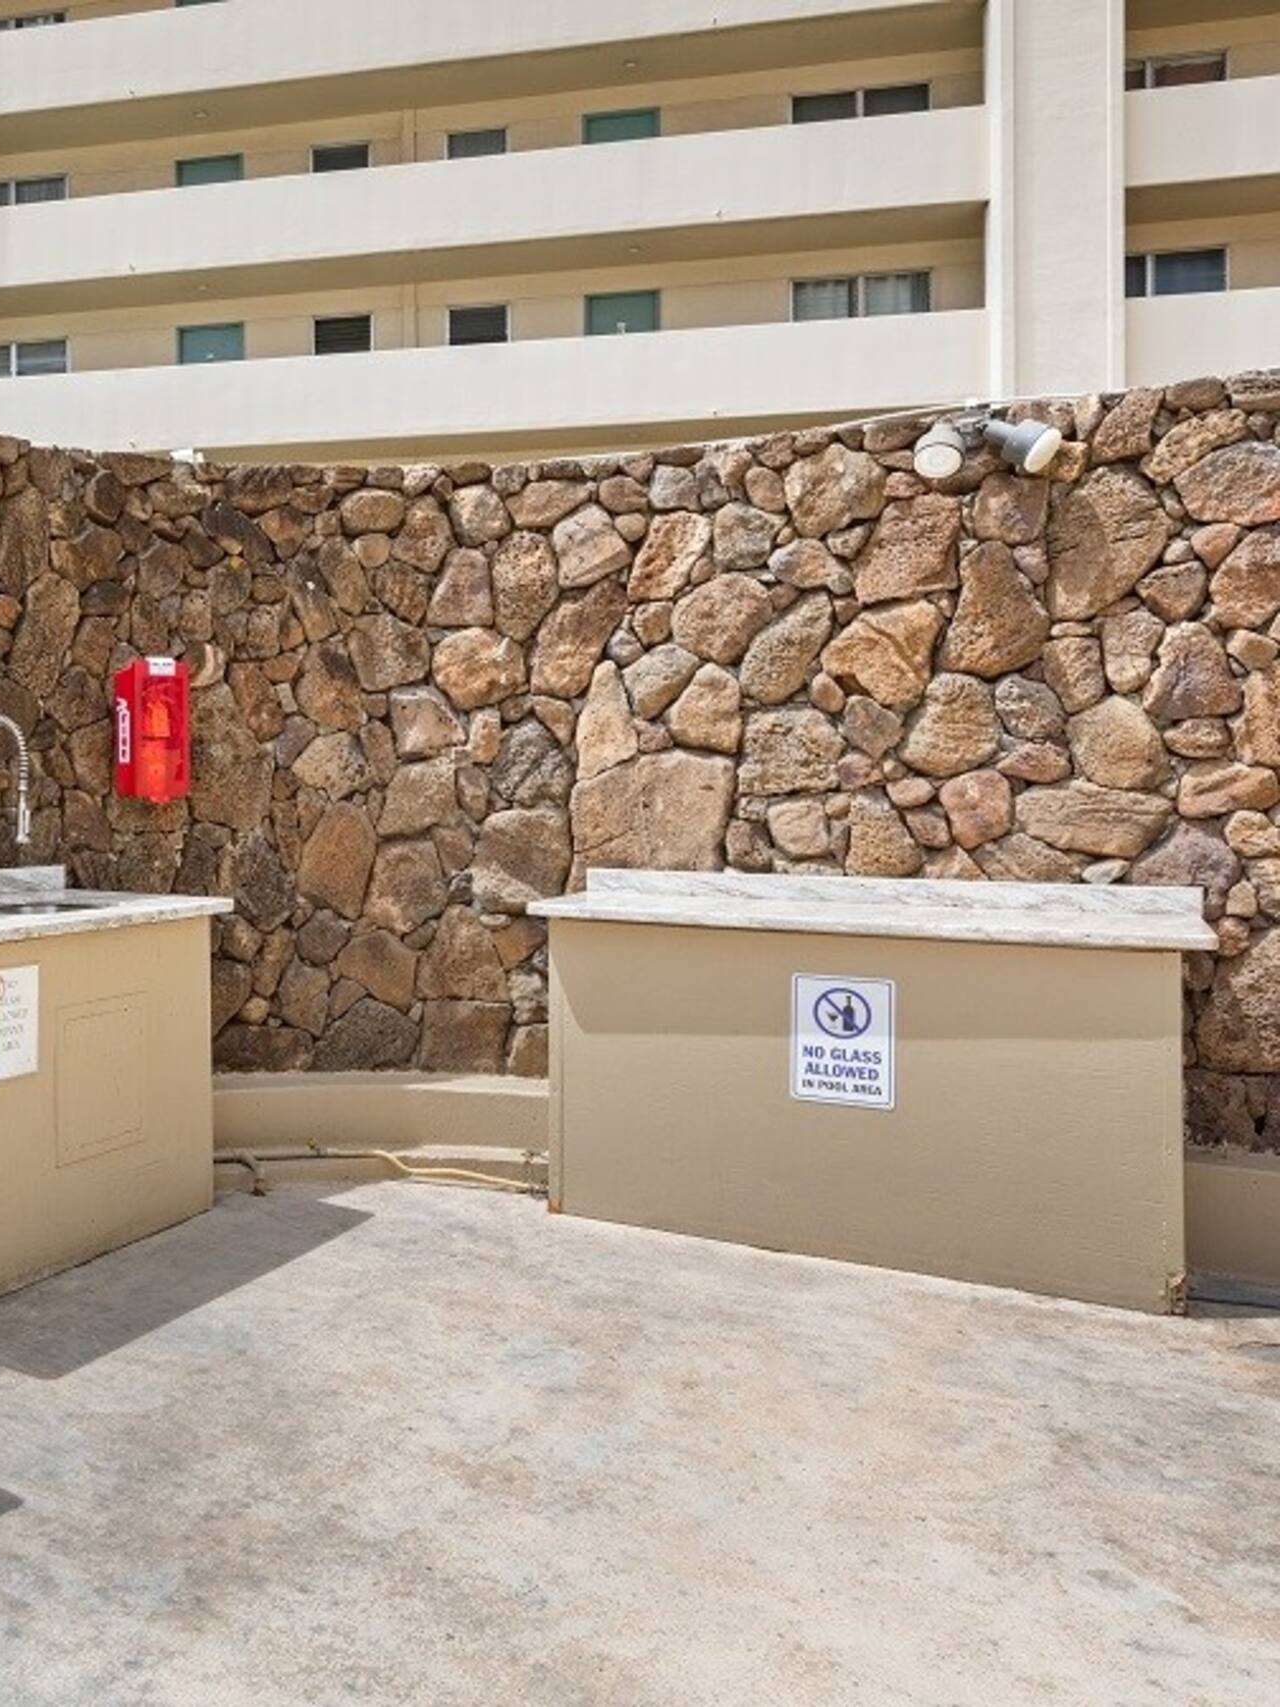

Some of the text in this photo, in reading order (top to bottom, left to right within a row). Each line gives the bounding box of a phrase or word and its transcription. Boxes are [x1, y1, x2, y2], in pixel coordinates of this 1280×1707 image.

[802, 1045, 882, 1065] NO GLASS
[804, 1061, 879, 1081] ALLOWED
[802, 1078, 883, 1096] IN POOL AREA
